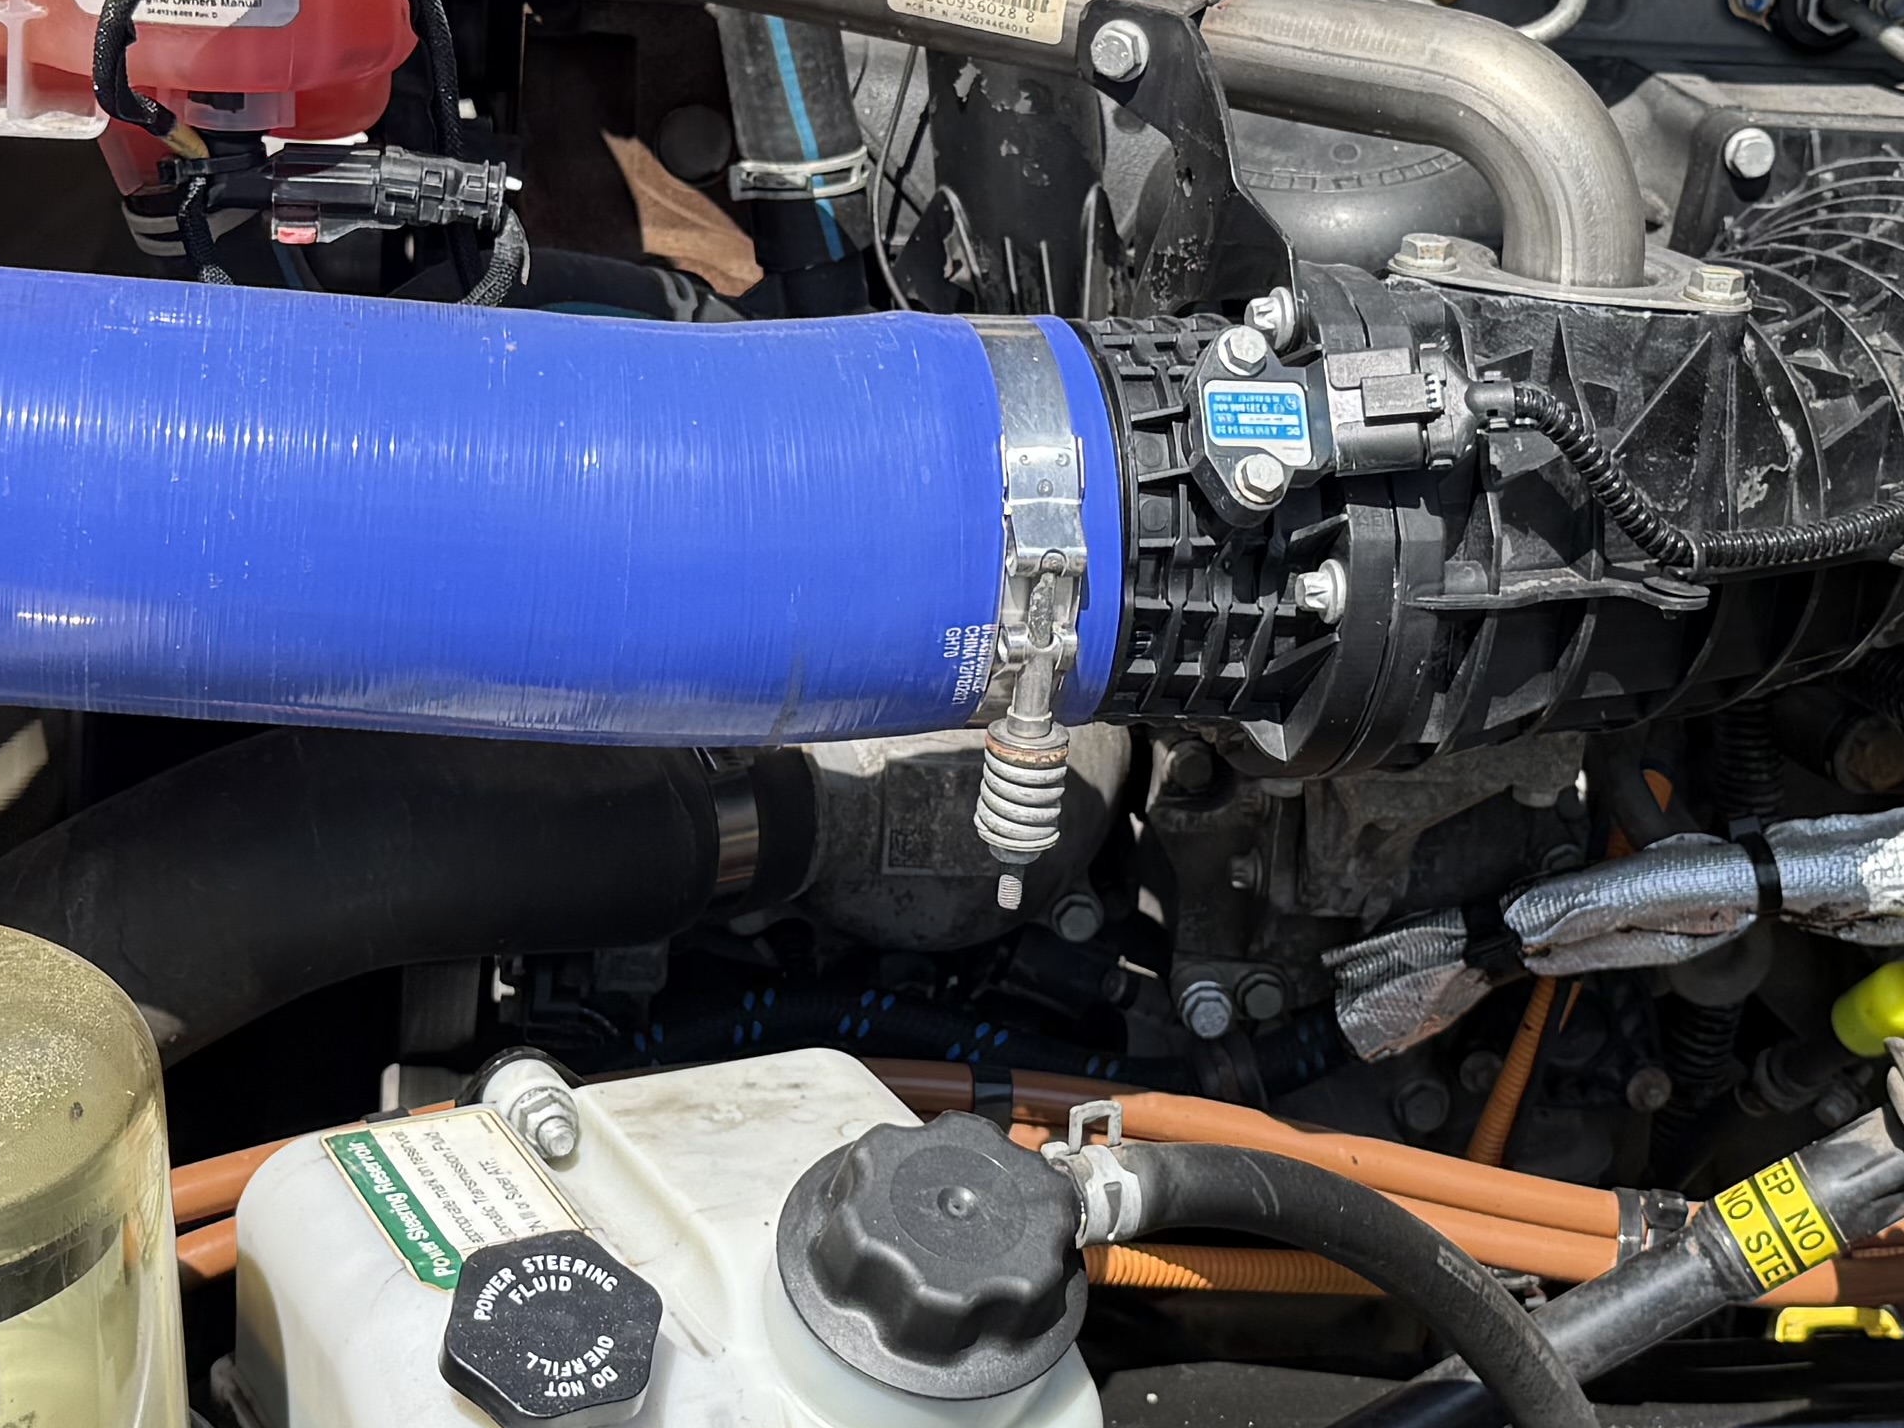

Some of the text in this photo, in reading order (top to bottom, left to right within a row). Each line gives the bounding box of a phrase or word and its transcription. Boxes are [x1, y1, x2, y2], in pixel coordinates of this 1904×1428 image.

[1026, 10, 1035, 23] 8
[943, 627, 962, 658] GH70
[962, 625, 981, 660] CHINA
[499, 1177, 524, 1201] Super
[1719, 1185, 1753, 1220] NO
[349, 1140, 457, 1278] Power Steering Reservoir
[1785, 1207, 1825, 1251] NO
[473, 1255, 619, 1321] POWER STEERING
[508, 1275, 572, 1305] FLUID
[527, 1335, 615, 1379] OVERFILL
[544, 1365, 619, 1397] DO NOT
